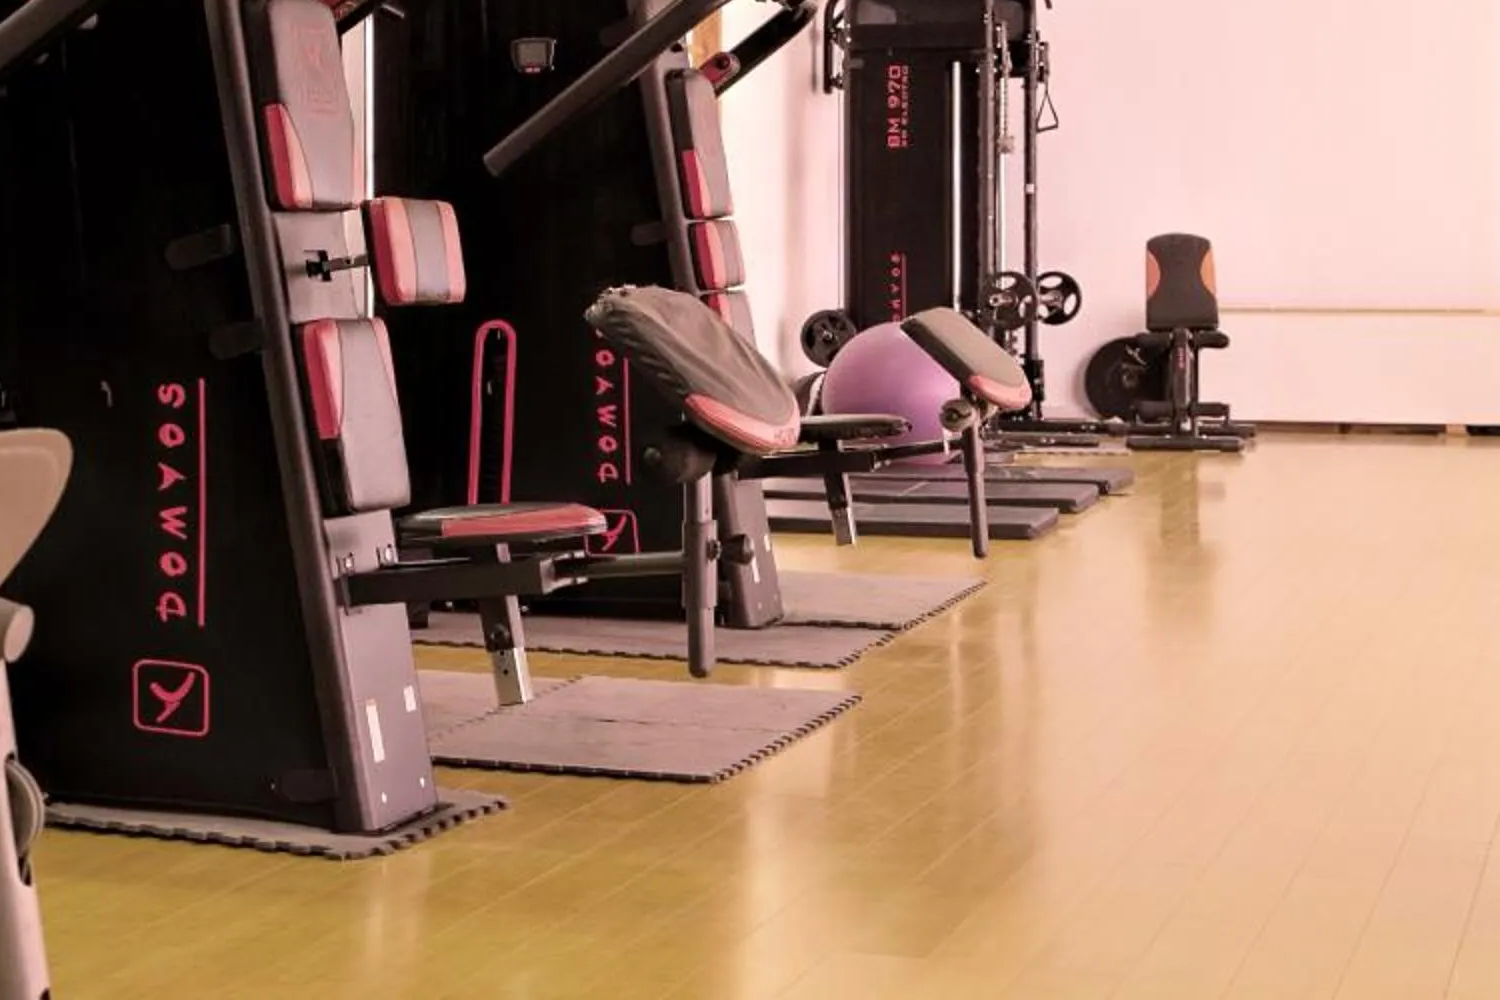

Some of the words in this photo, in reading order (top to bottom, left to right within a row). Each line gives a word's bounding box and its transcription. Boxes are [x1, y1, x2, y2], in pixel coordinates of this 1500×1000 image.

[891, 253, 901, 322] OMYOS
[596, 328, 619, 484] DOMYO
[157, 383, 187, 621] DOMYOS
